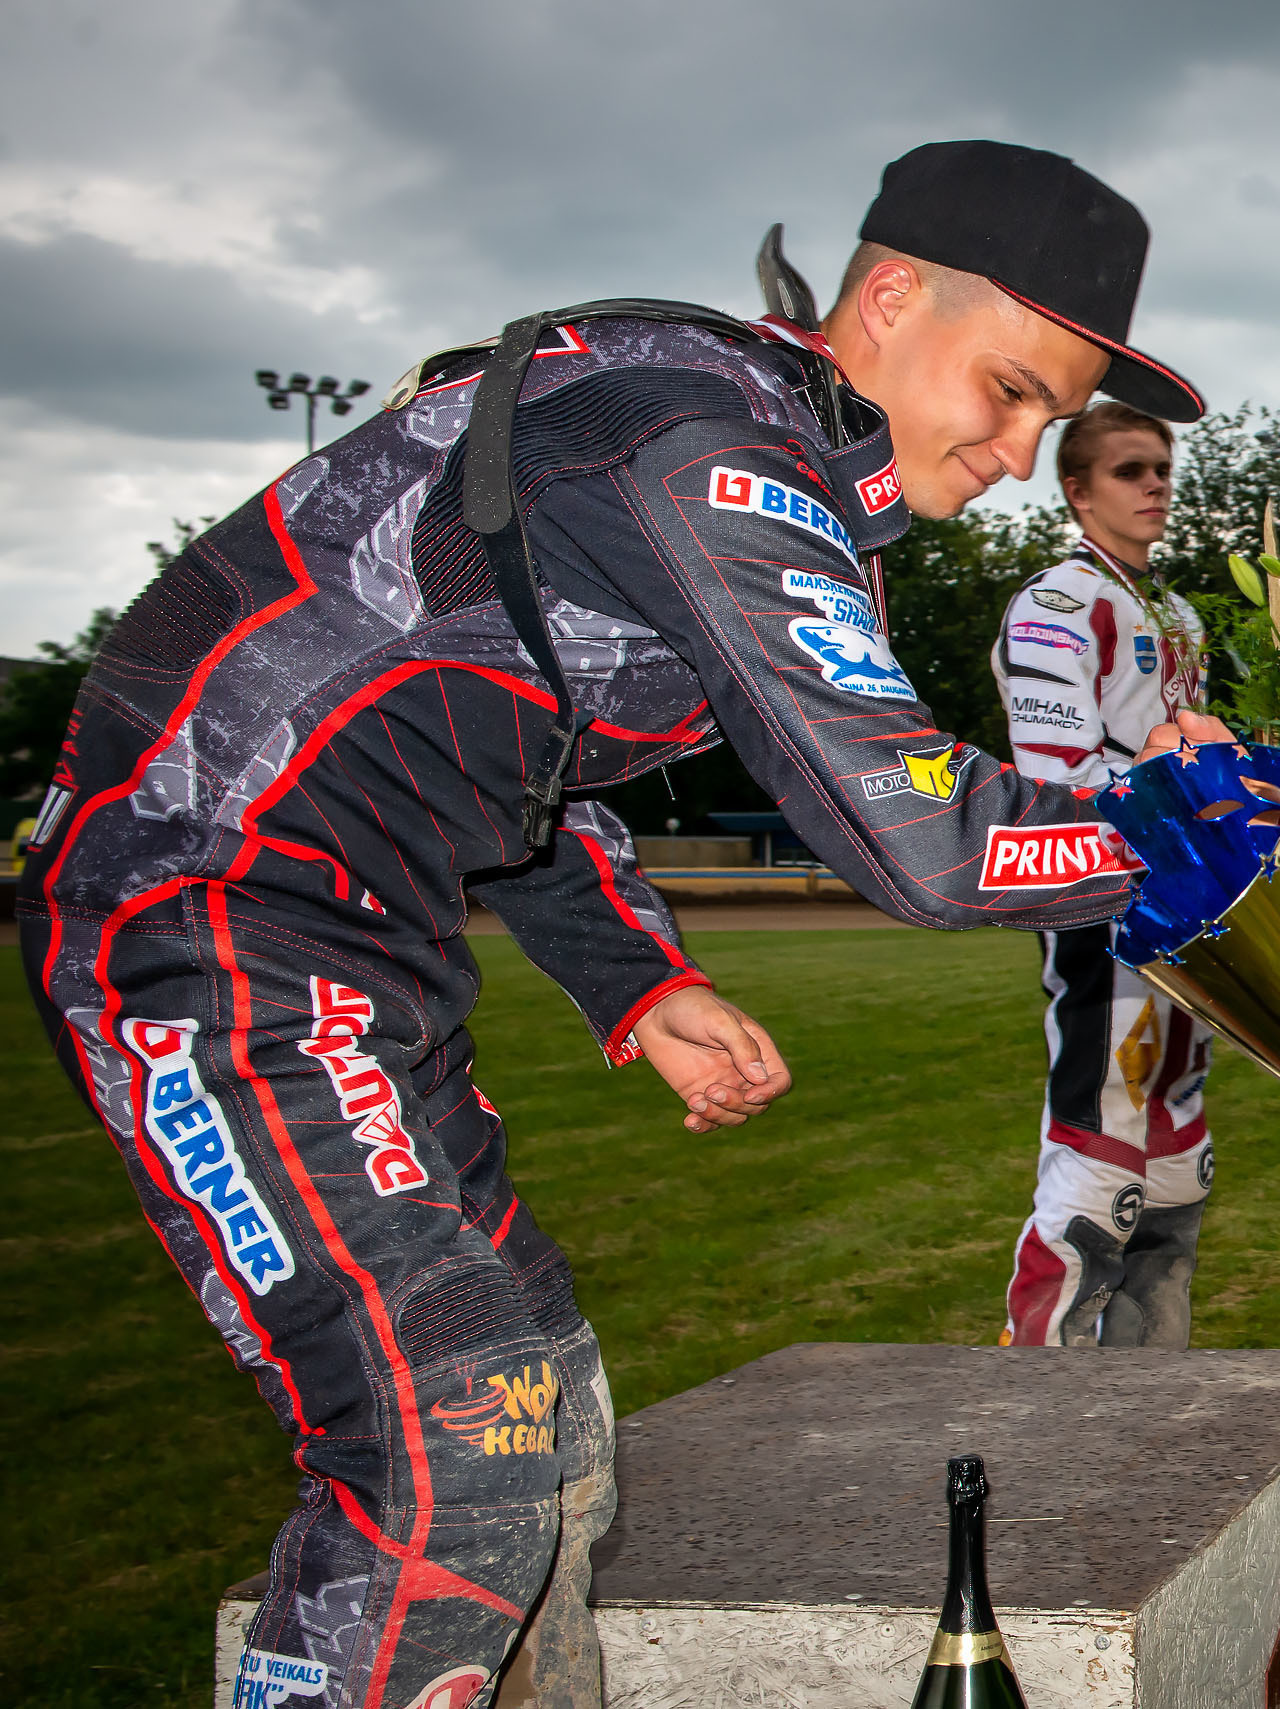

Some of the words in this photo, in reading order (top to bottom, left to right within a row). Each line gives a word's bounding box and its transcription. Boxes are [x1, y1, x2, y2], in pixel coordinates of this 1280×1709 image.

[1011, 696, 1085, 722] MIHAIL
[866, 771, 911, 795] MOTO
[152, 1067, 286, 1286] BERNER
[266, 1656, 324, 1686] VEIKALS
